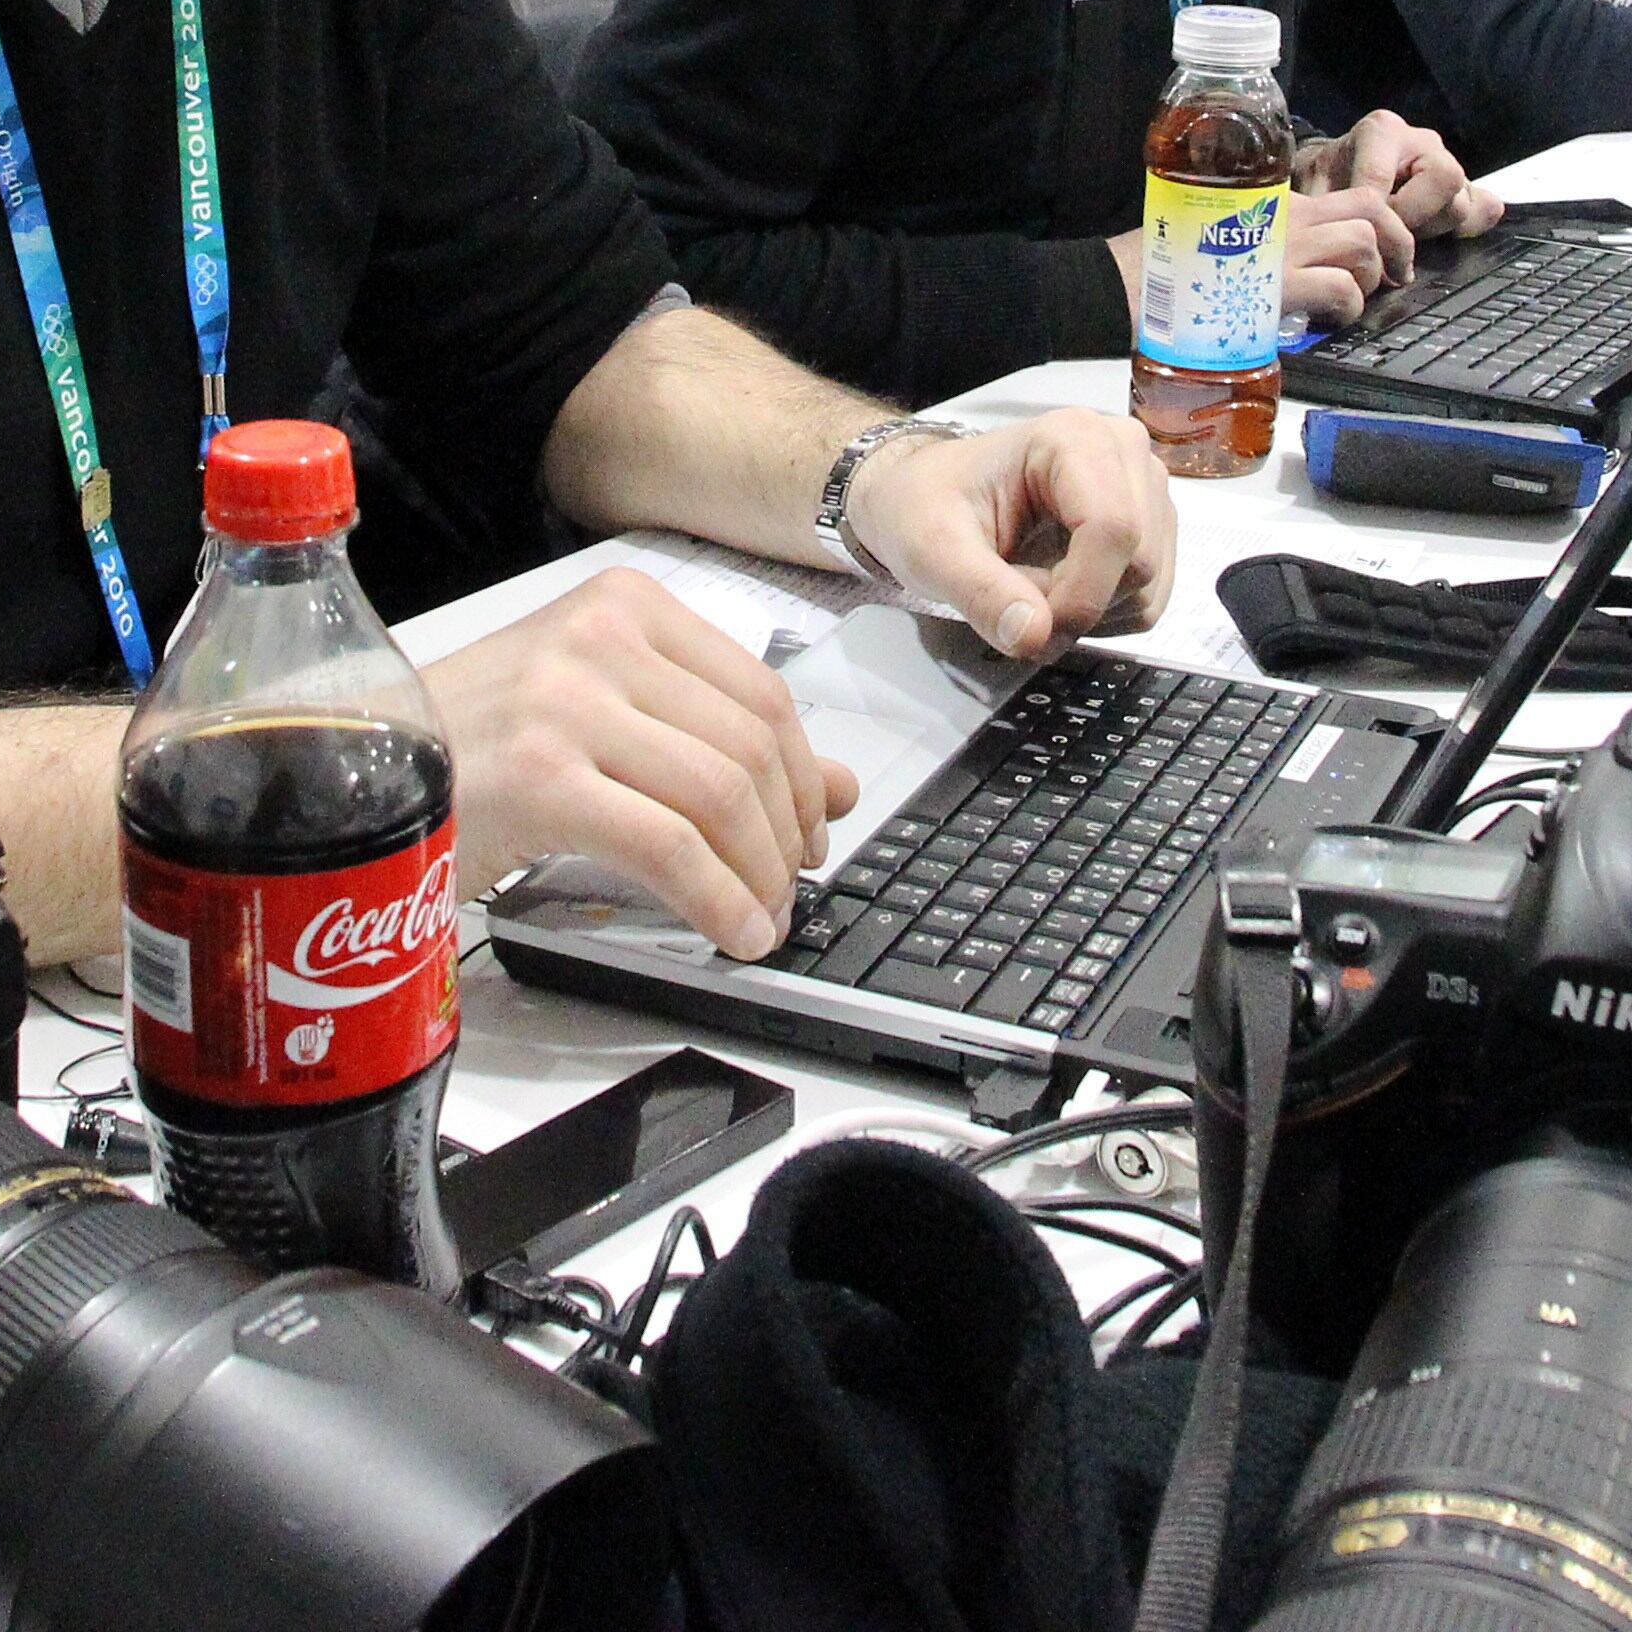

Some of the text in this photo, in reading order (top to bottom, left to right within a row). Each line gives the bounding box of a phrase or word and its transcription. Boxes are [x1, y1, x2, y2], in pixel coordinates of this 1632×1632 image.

[179, 55, 214, 241] vancouver
[1202, 222, 1272, 247] NESTEA
[98, 560, 134, 638] 2010
